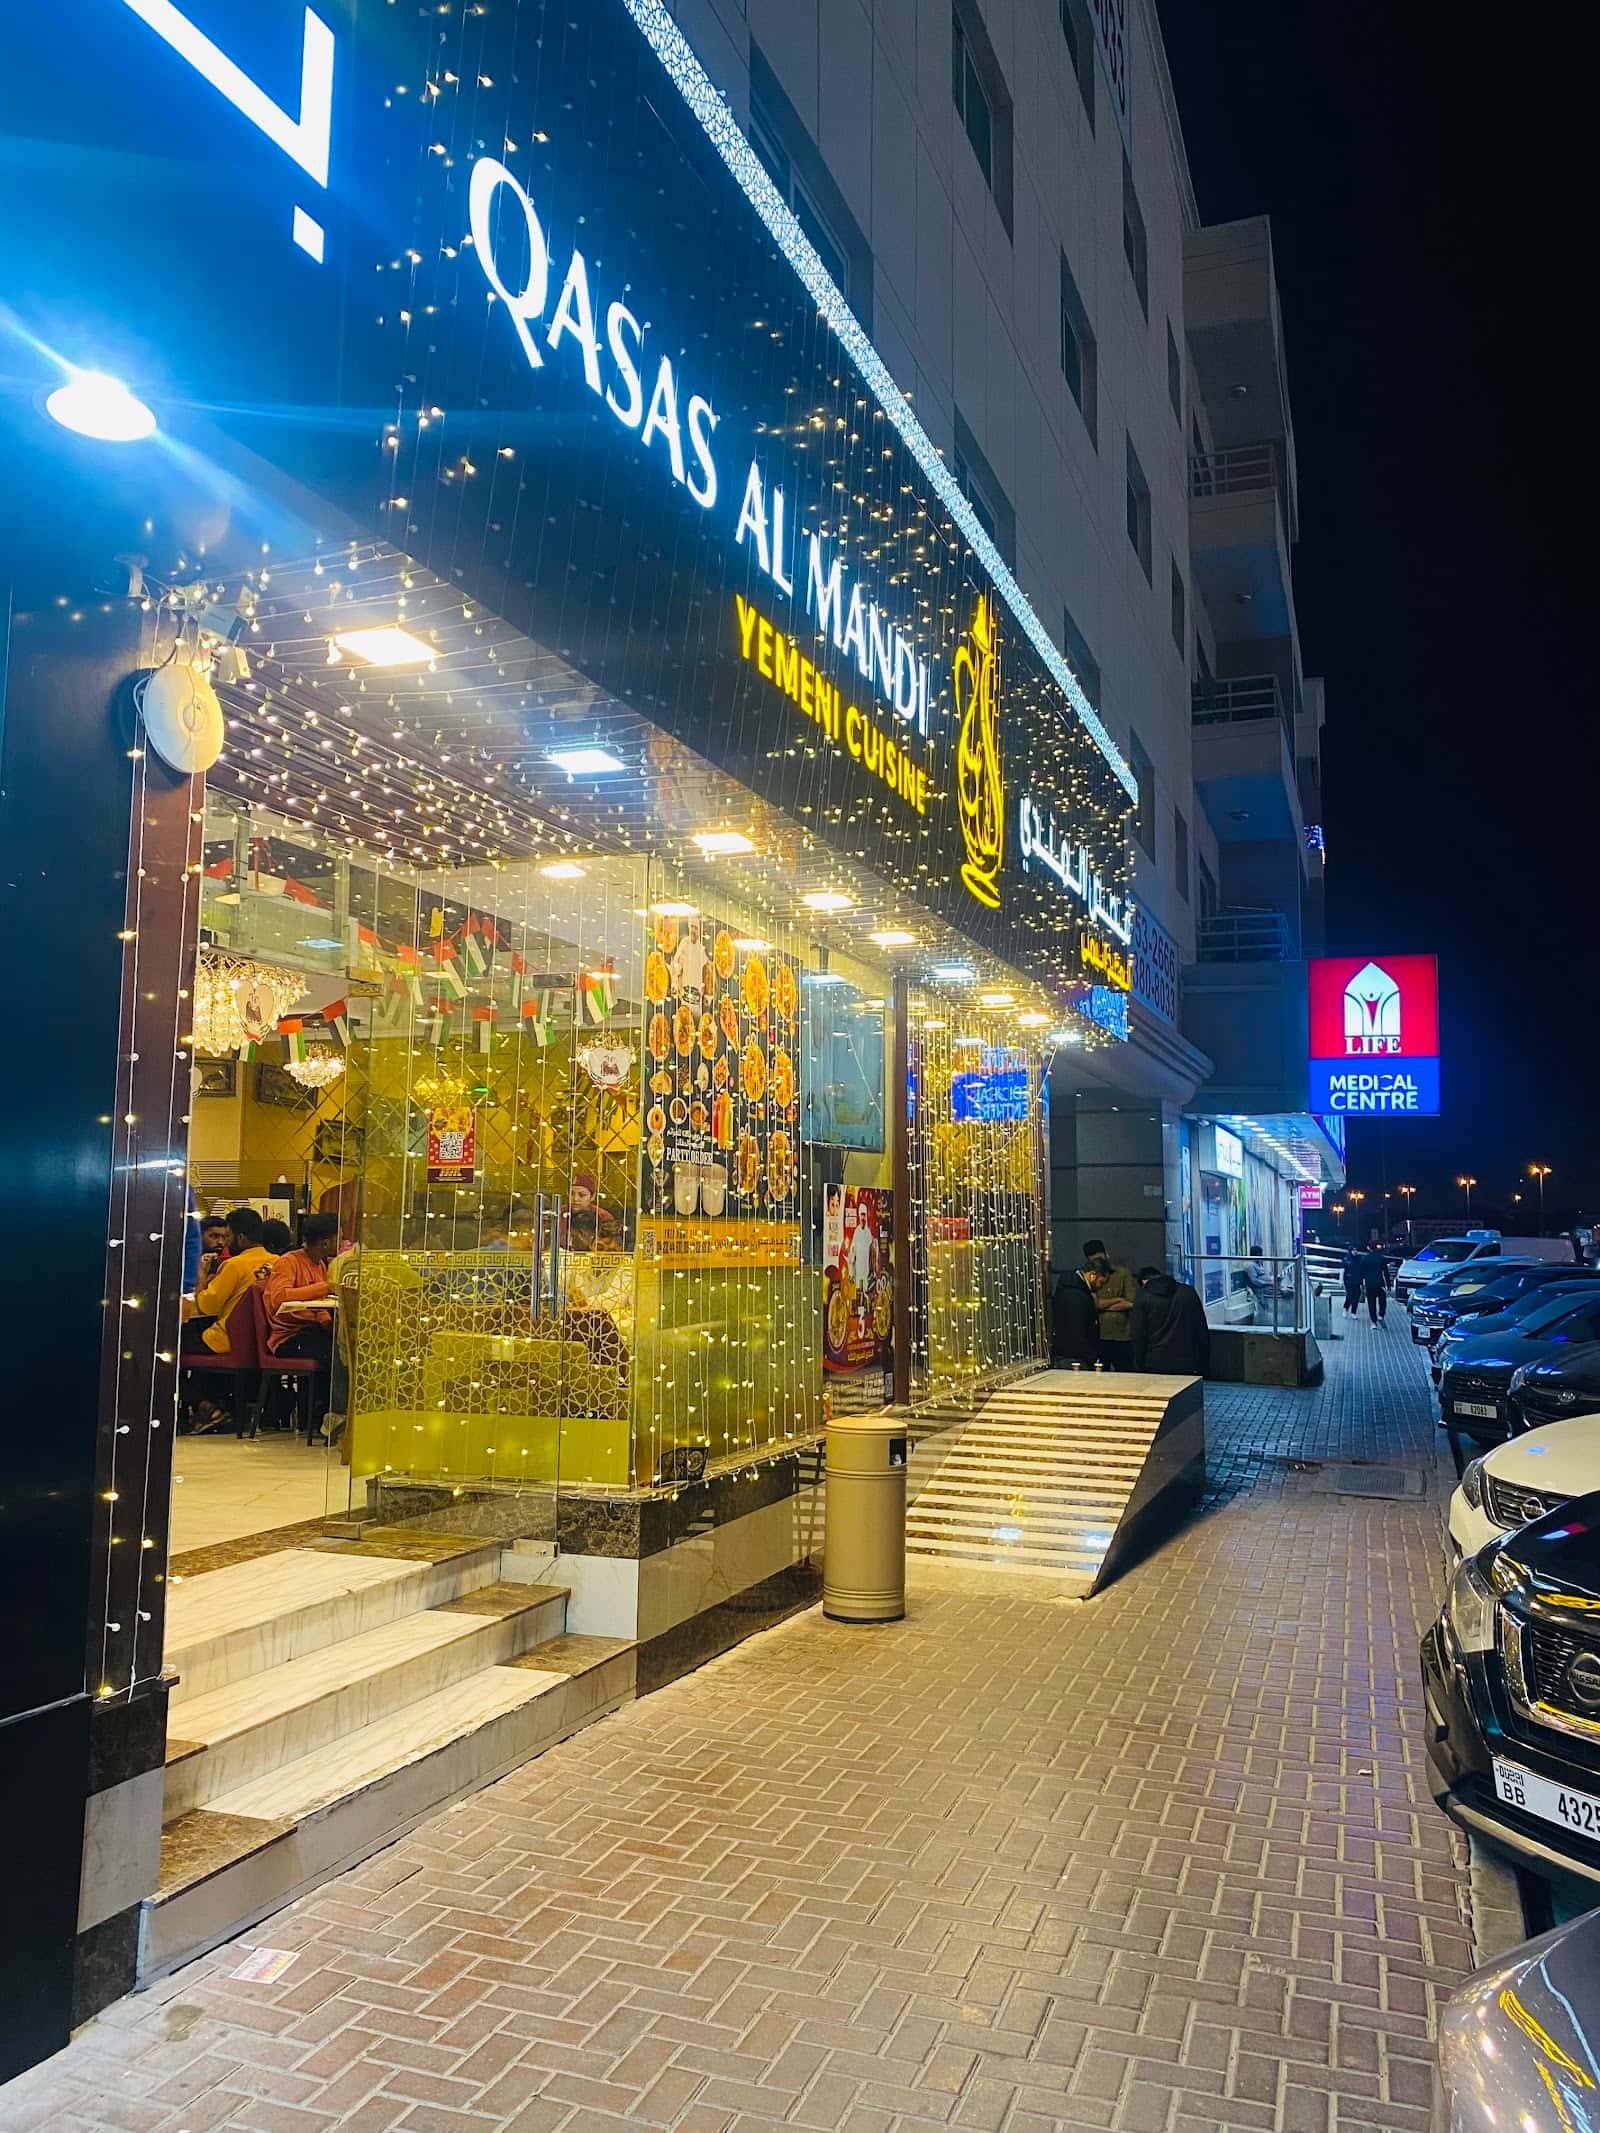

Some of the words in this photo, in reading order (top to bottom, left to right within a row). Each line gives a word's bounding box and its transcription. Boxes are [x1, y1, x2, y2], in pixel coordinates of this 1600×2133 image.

[469, 156, 718, 509] QASAS
[735, 460, 793, 597] AL
[805, 532, 930, 738] MANDI
[735, 593, 840, 741] YEMENI
[845, 704, 928, 816] CUISINE
[1344, 1036, 1402, 1055] LIFE
[1330, 1074, 1418, 1091] MEDICAL
[1330, 1091, 1419, 1110] CENTRE
[666, 1147, 690, 1162] PARTY
[1571, 1671, 1600, 1687] NISSA
[1503, 1782, 1526, 1806] BB
